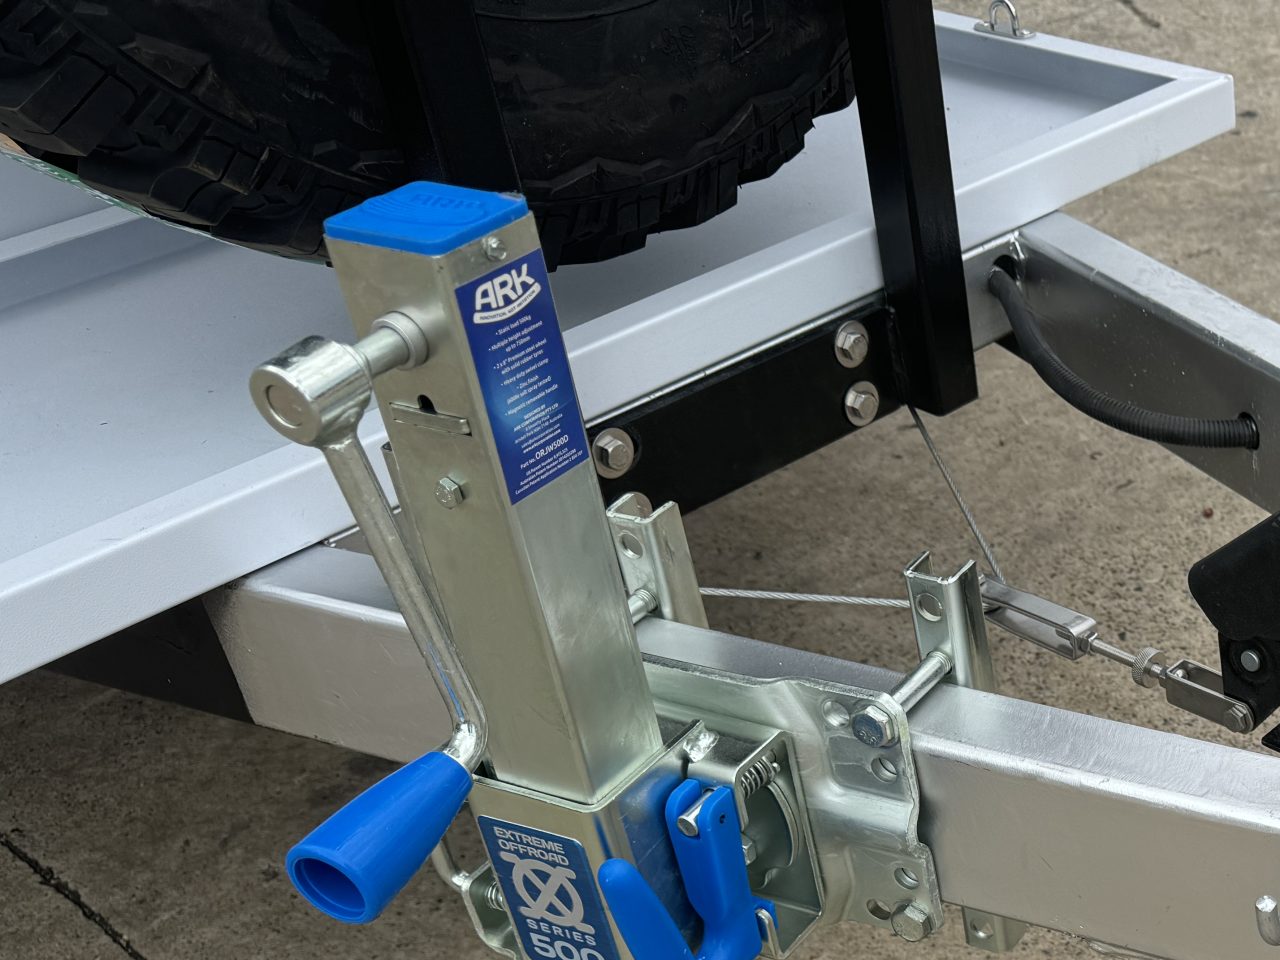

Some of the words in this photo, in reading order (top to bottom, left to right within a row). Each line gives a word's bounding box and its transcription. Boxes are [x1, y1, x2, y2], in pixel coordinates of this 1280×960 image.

[475, 263, 535, 310] ARK
[535, 433, 568, 460] ORJW500D
[493, 827, 566, 855] EXTREME
[498, 839, 570, 866] OFFROAD
[526, 918, 597, 946] SERIES
